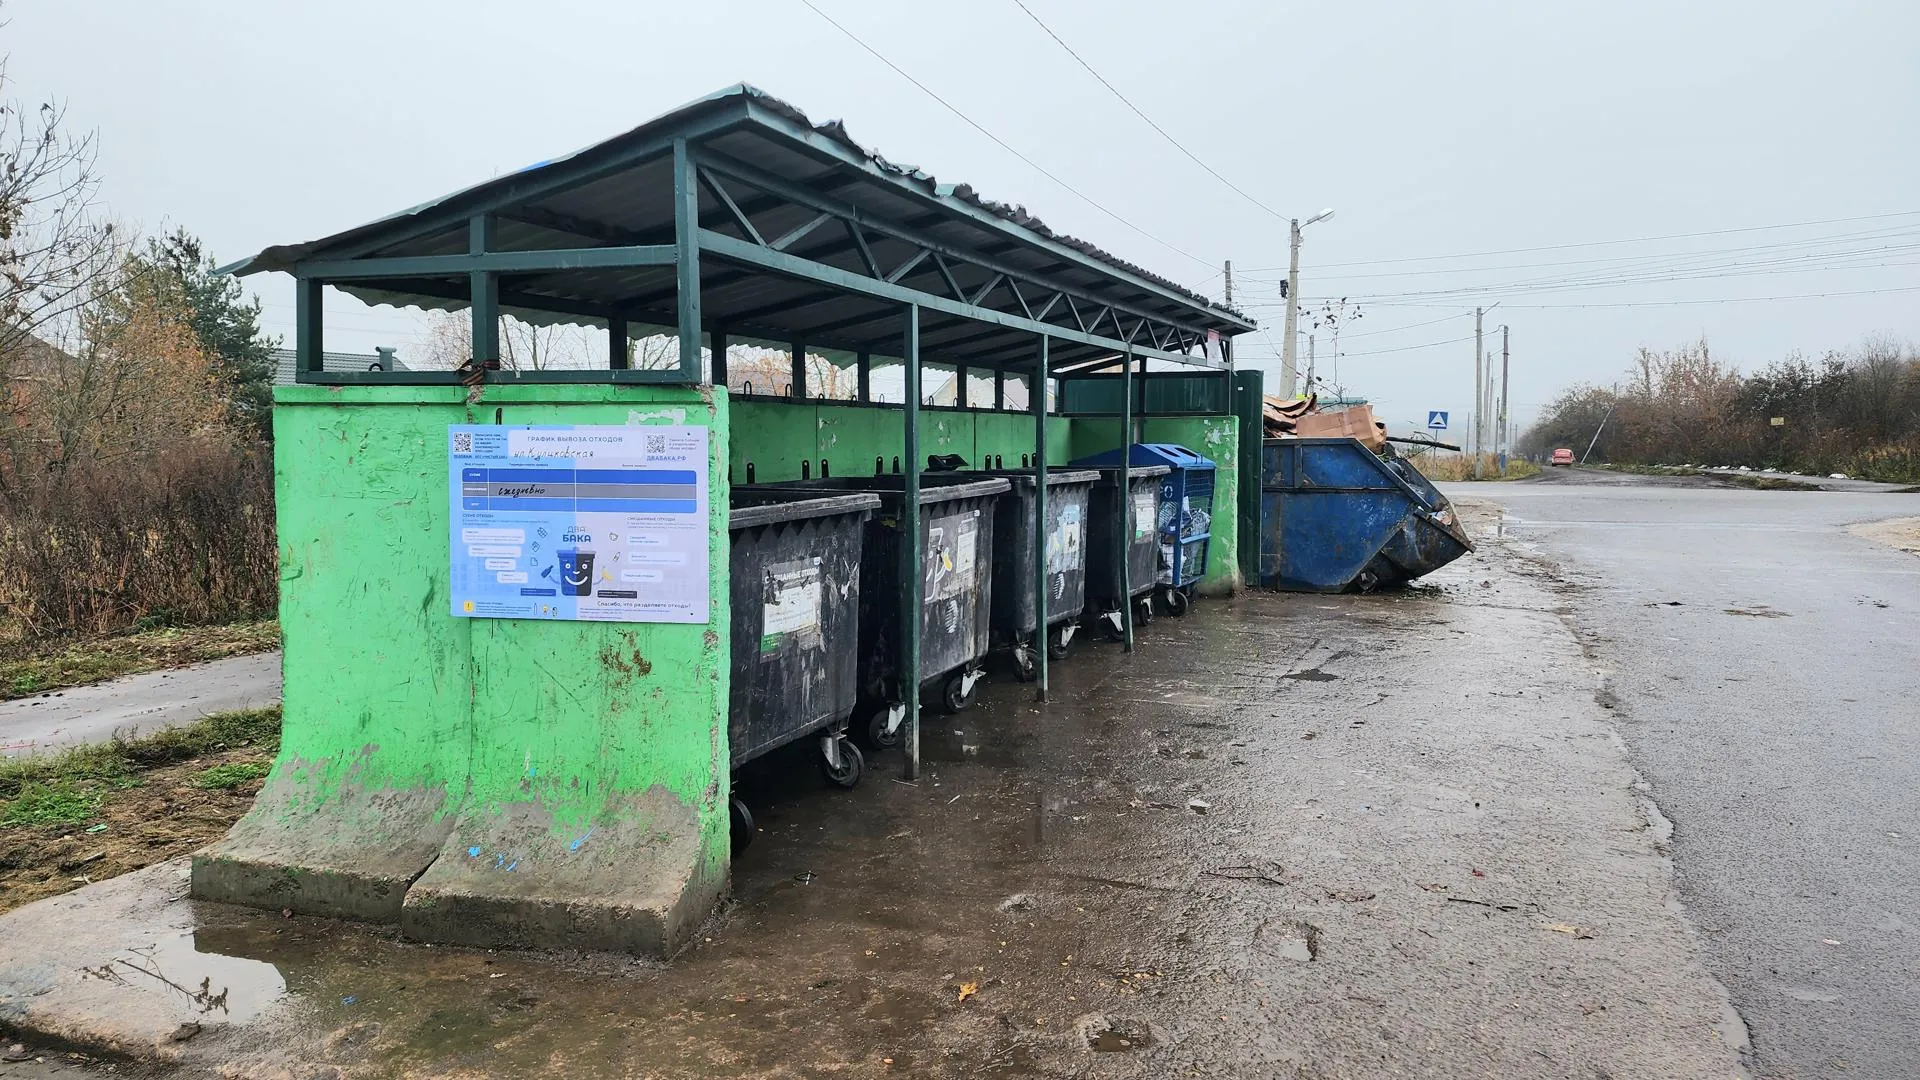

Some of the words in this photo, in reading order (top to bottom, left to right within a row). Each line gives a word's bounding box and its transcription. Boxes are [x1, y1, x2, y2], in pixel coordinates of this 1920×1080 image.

[588, 436, 623, 444] ОТХОДОВ
[498, 484, 546, 499] ежедневно
[562, 534, 591, 542] БАКА
[597, 600, 622, 608] Спасибо,
